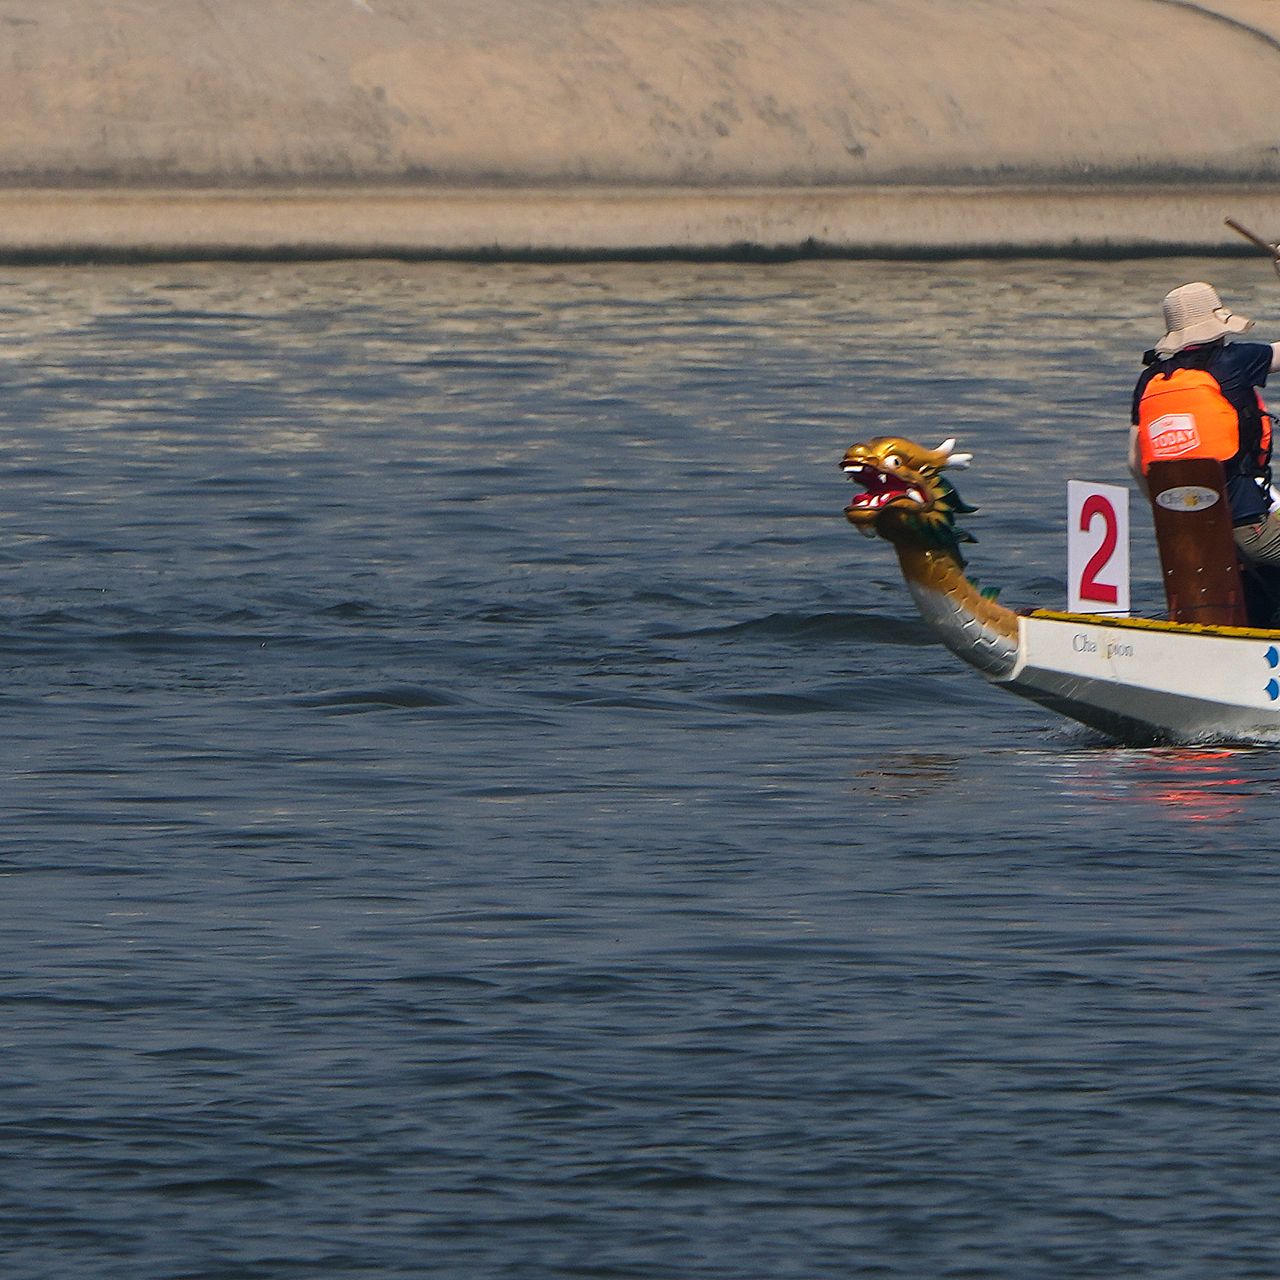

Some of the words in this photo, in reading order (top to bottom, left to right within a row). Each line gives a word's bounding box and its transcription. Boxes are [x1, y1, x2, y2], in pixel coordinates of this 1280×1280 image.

[1152, 429, 1196, 450] TODAY
[1080, 495, 1117, 604] 2
[1073, 634, 1134, 659] Chapion
